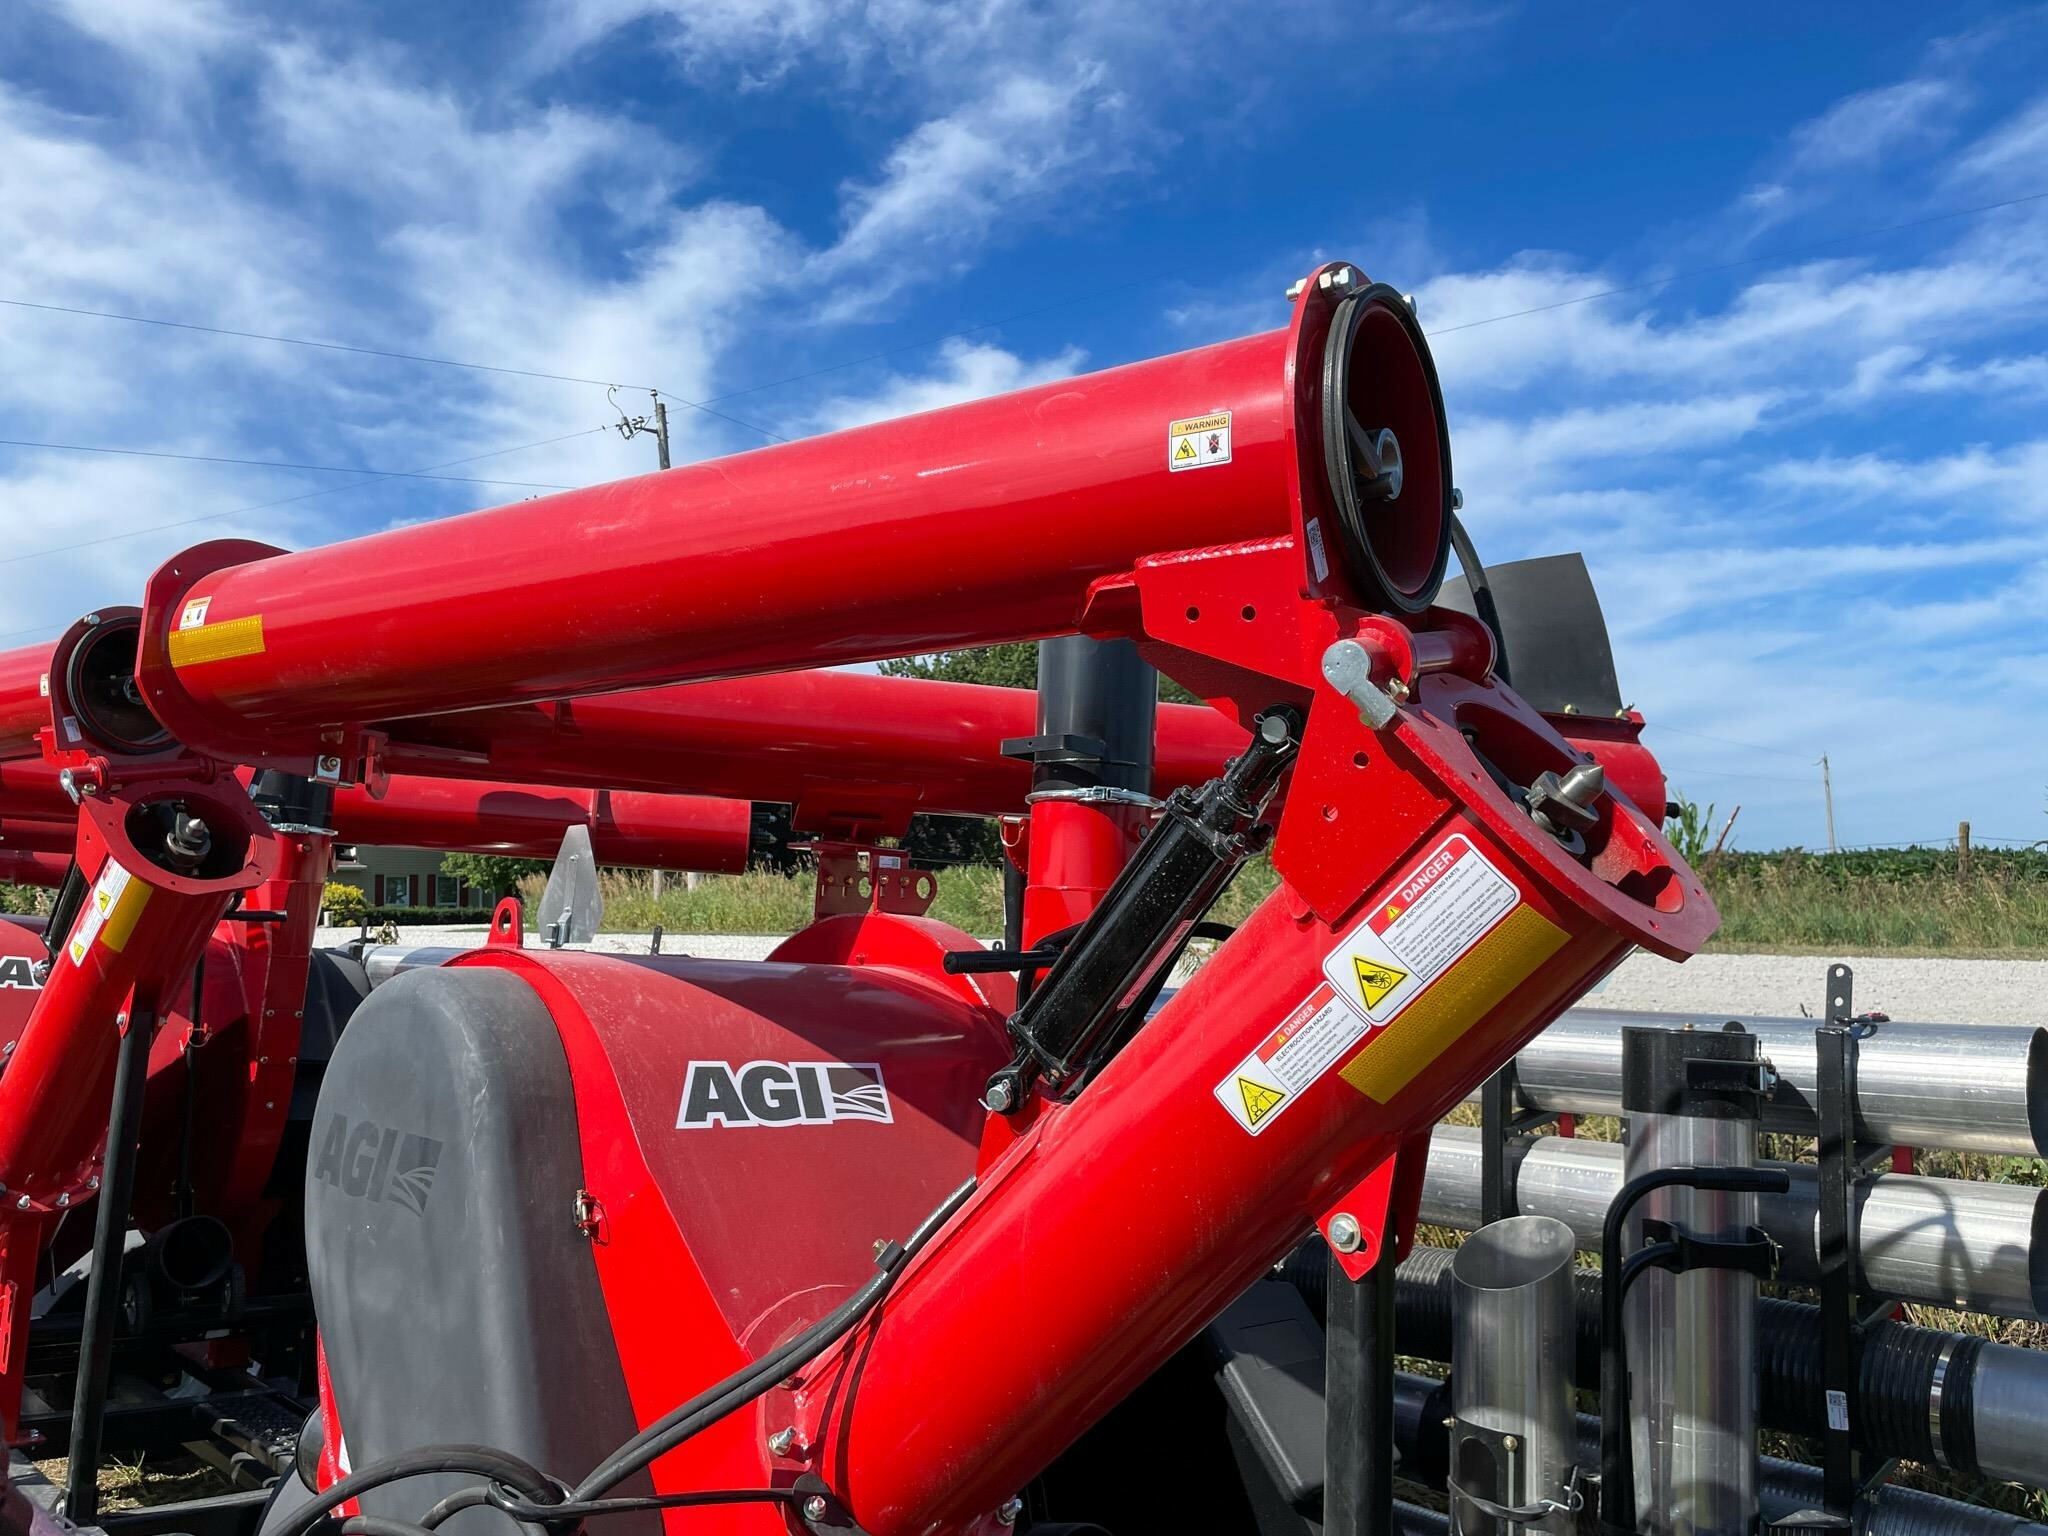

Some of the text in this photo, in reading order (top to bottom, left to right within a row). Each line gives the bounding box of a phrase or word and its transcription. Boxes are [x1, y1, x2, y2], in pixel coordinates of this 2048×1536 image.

[1184, 417, 1227, 432] WARNING
[1395, 916, 1407, 928] HIGH
[1444, 866, 1460, 882] PARTS
[1400, 850, 1455, 902] DANGER
[0, 959, 43, 987] A
[1275, 1006, 1332, 1061] ELECTROCUTION HAZARD
[1282, 1003, 1316, 1036] DANGER
[682, 1063, 830, 1125] AGI
[315, 1113, 398, 1203] AGI
